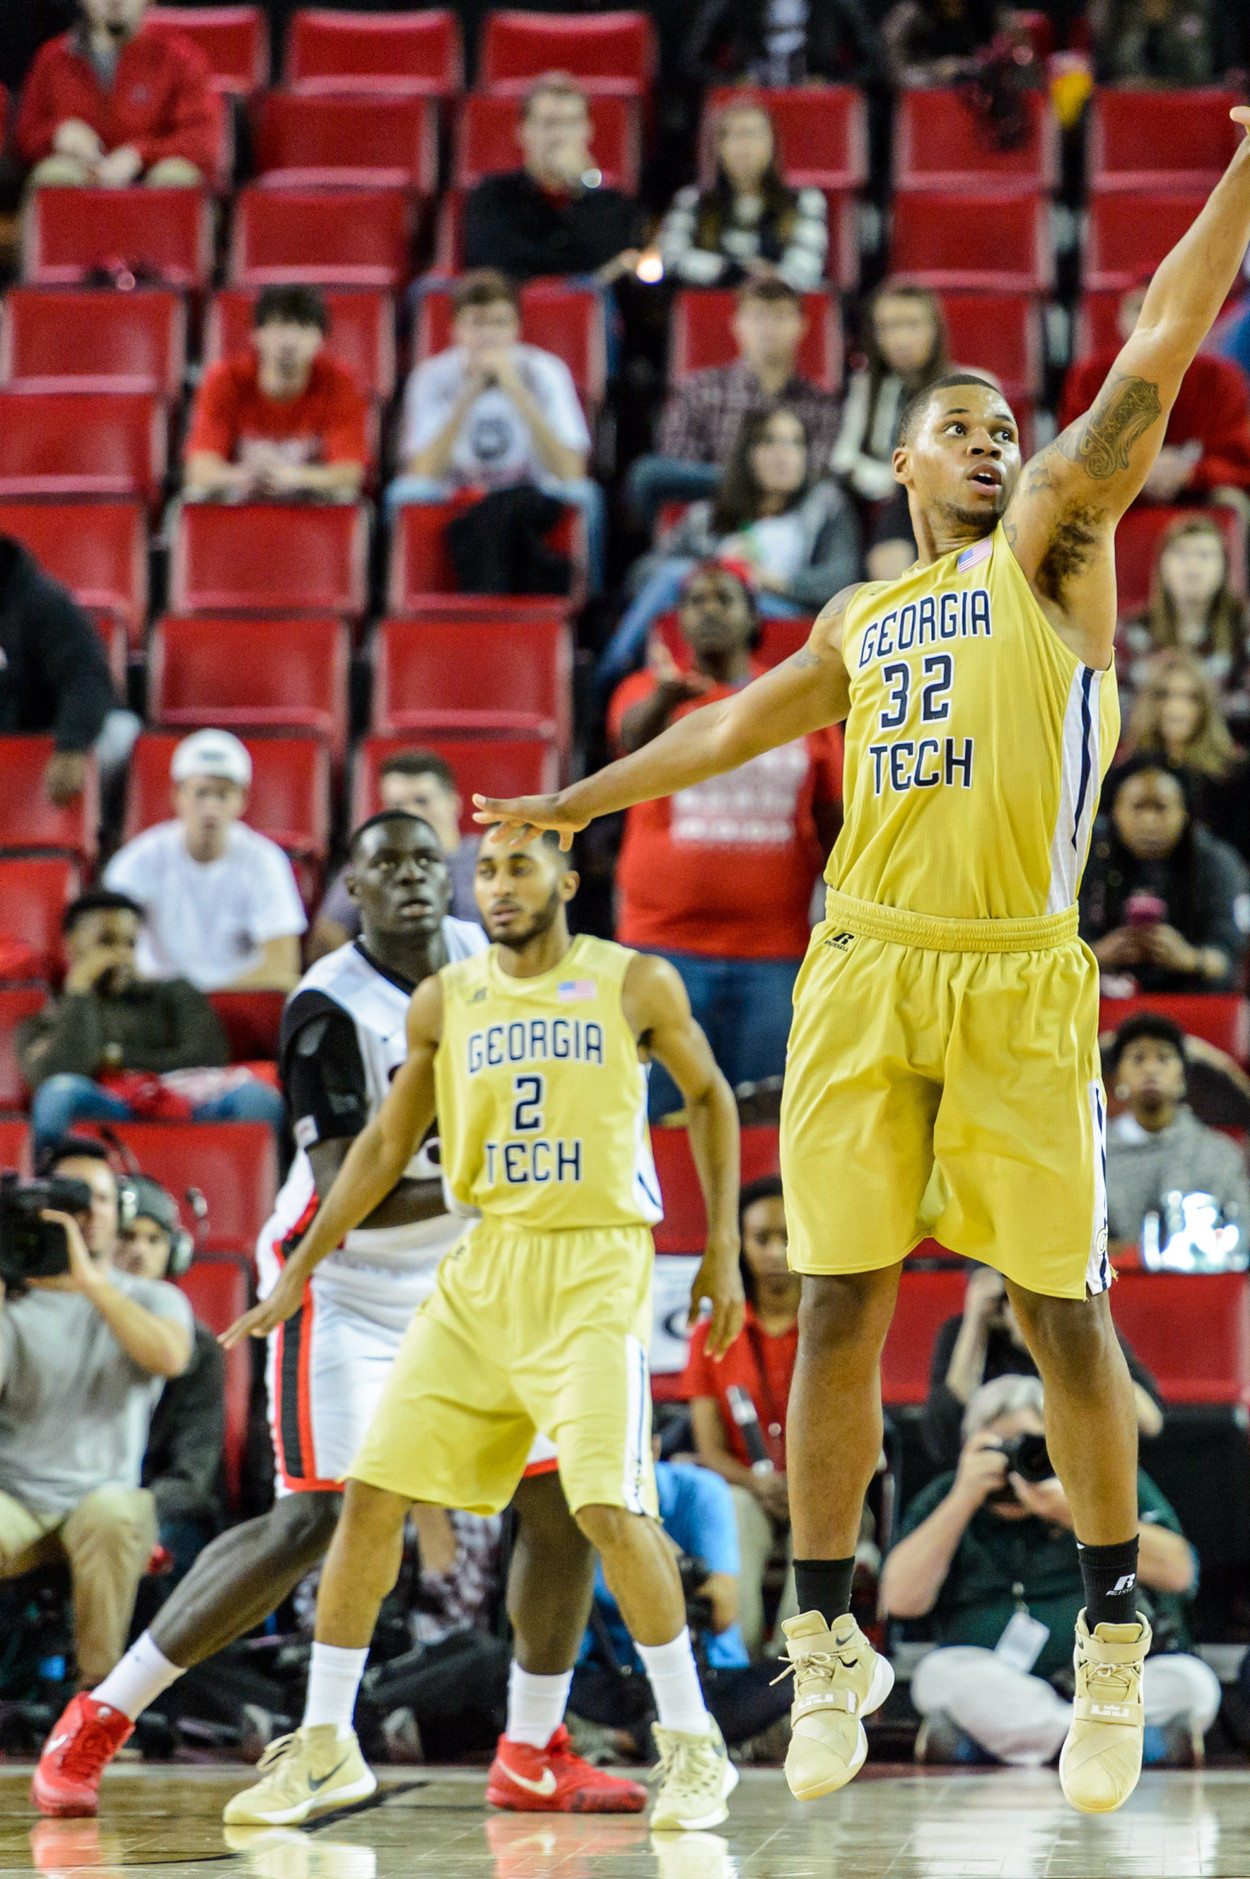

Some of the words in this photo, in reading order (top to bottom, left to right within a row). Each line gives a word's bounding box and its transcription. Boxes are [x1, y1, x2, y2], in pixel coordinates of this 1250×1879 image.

[857, 588, 992, 670] GEORGIA
[880, 653, 953, 730] 32
[868, 737, 974, 796] TECH
[467, 1019, 604, 1075] GEORGIA
[514, 1075, 544, 1131] 2
[485, 1140, 582, 1186] TECH
